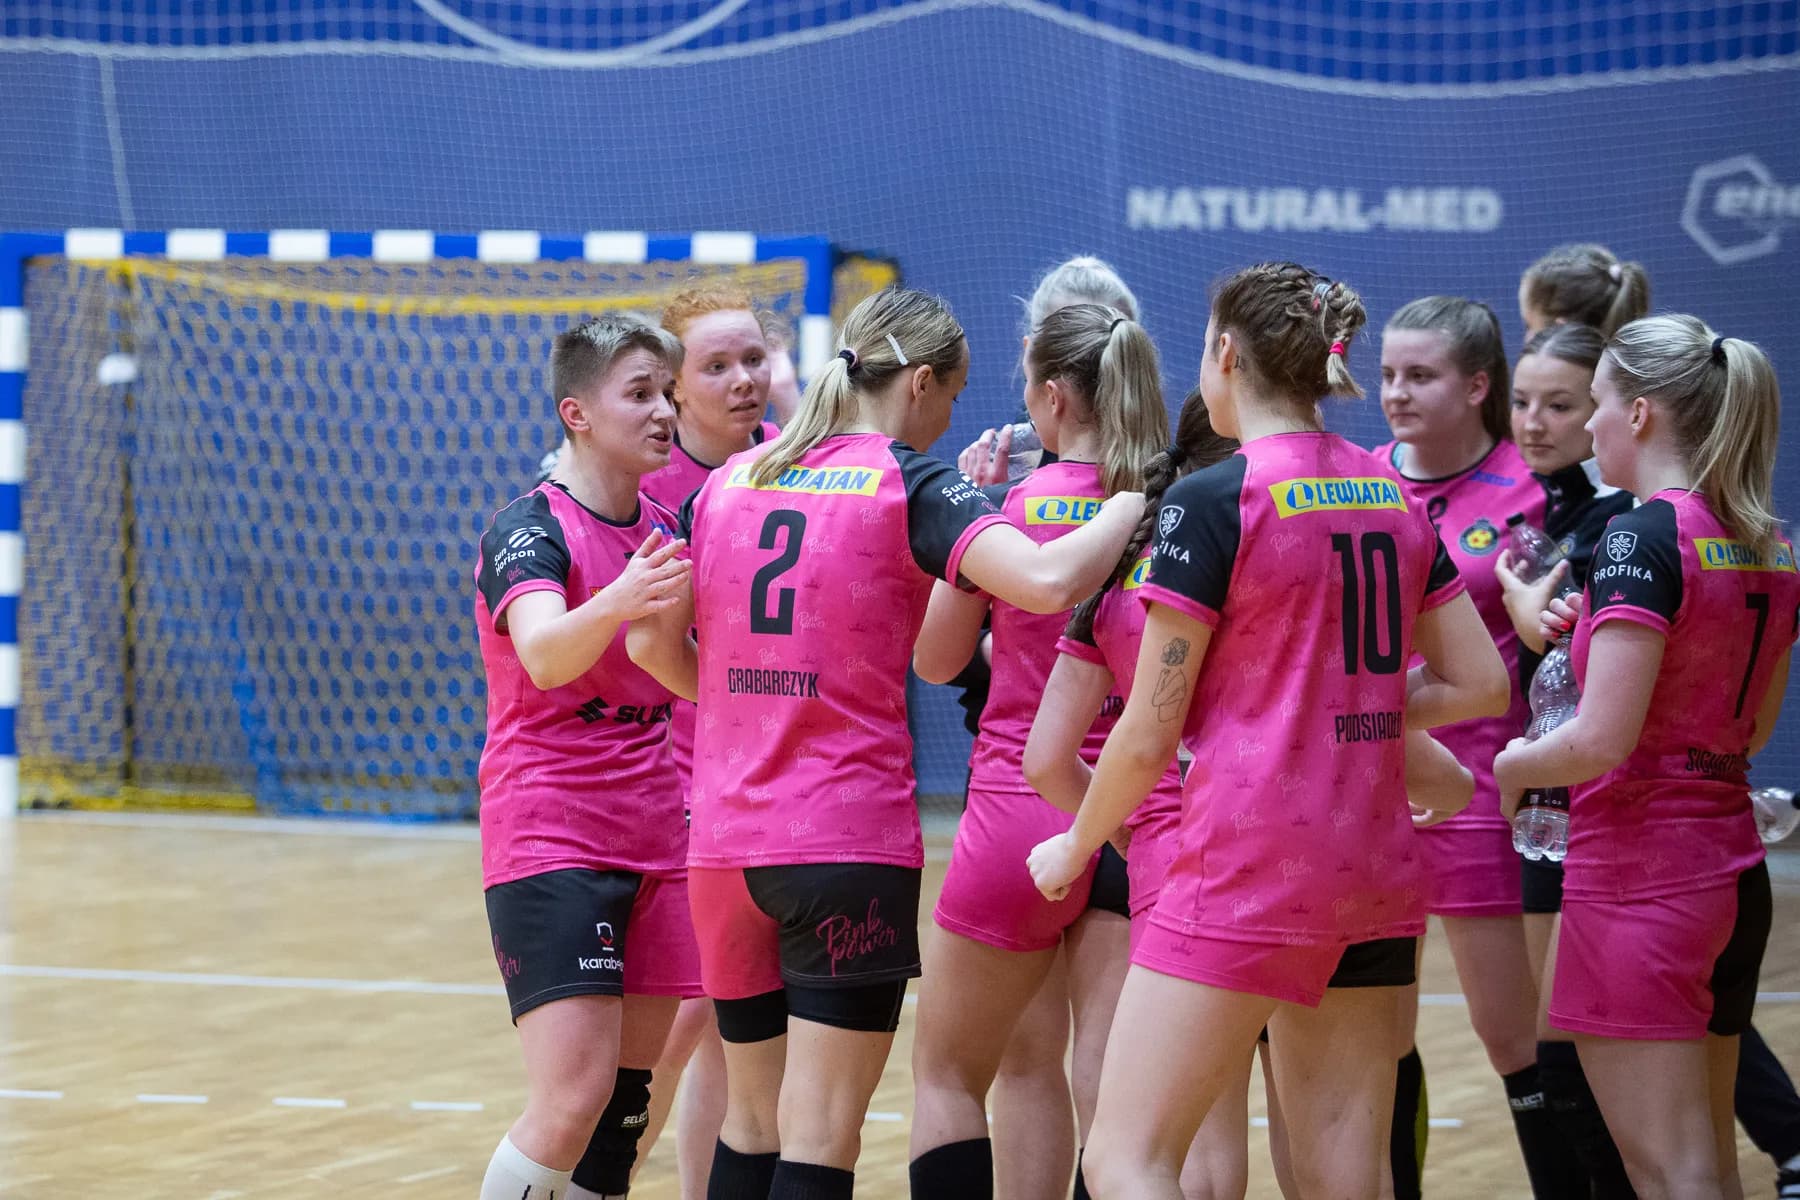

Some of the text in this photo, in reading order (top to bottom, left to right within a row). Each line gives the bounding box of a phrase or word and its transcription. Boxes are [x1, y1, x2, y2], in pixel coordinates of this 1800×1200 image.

[1126, 187, 1502, 232] NATURAL-MED
[942, 482, 968, 498] Sun
[494, 547, 507, 566] Sun
[495, 549, 536, 577] Horizon
[750, 509, 807, 635] 2
[1593, 564, 1654, 585] PROFIKA
[1331, 531, 1402, 676] 10
[1733, 593, 1770, 720] 7
[728, 667, 820, 699] GRABARCZYK
[815, 897, 882, 955] Pink
